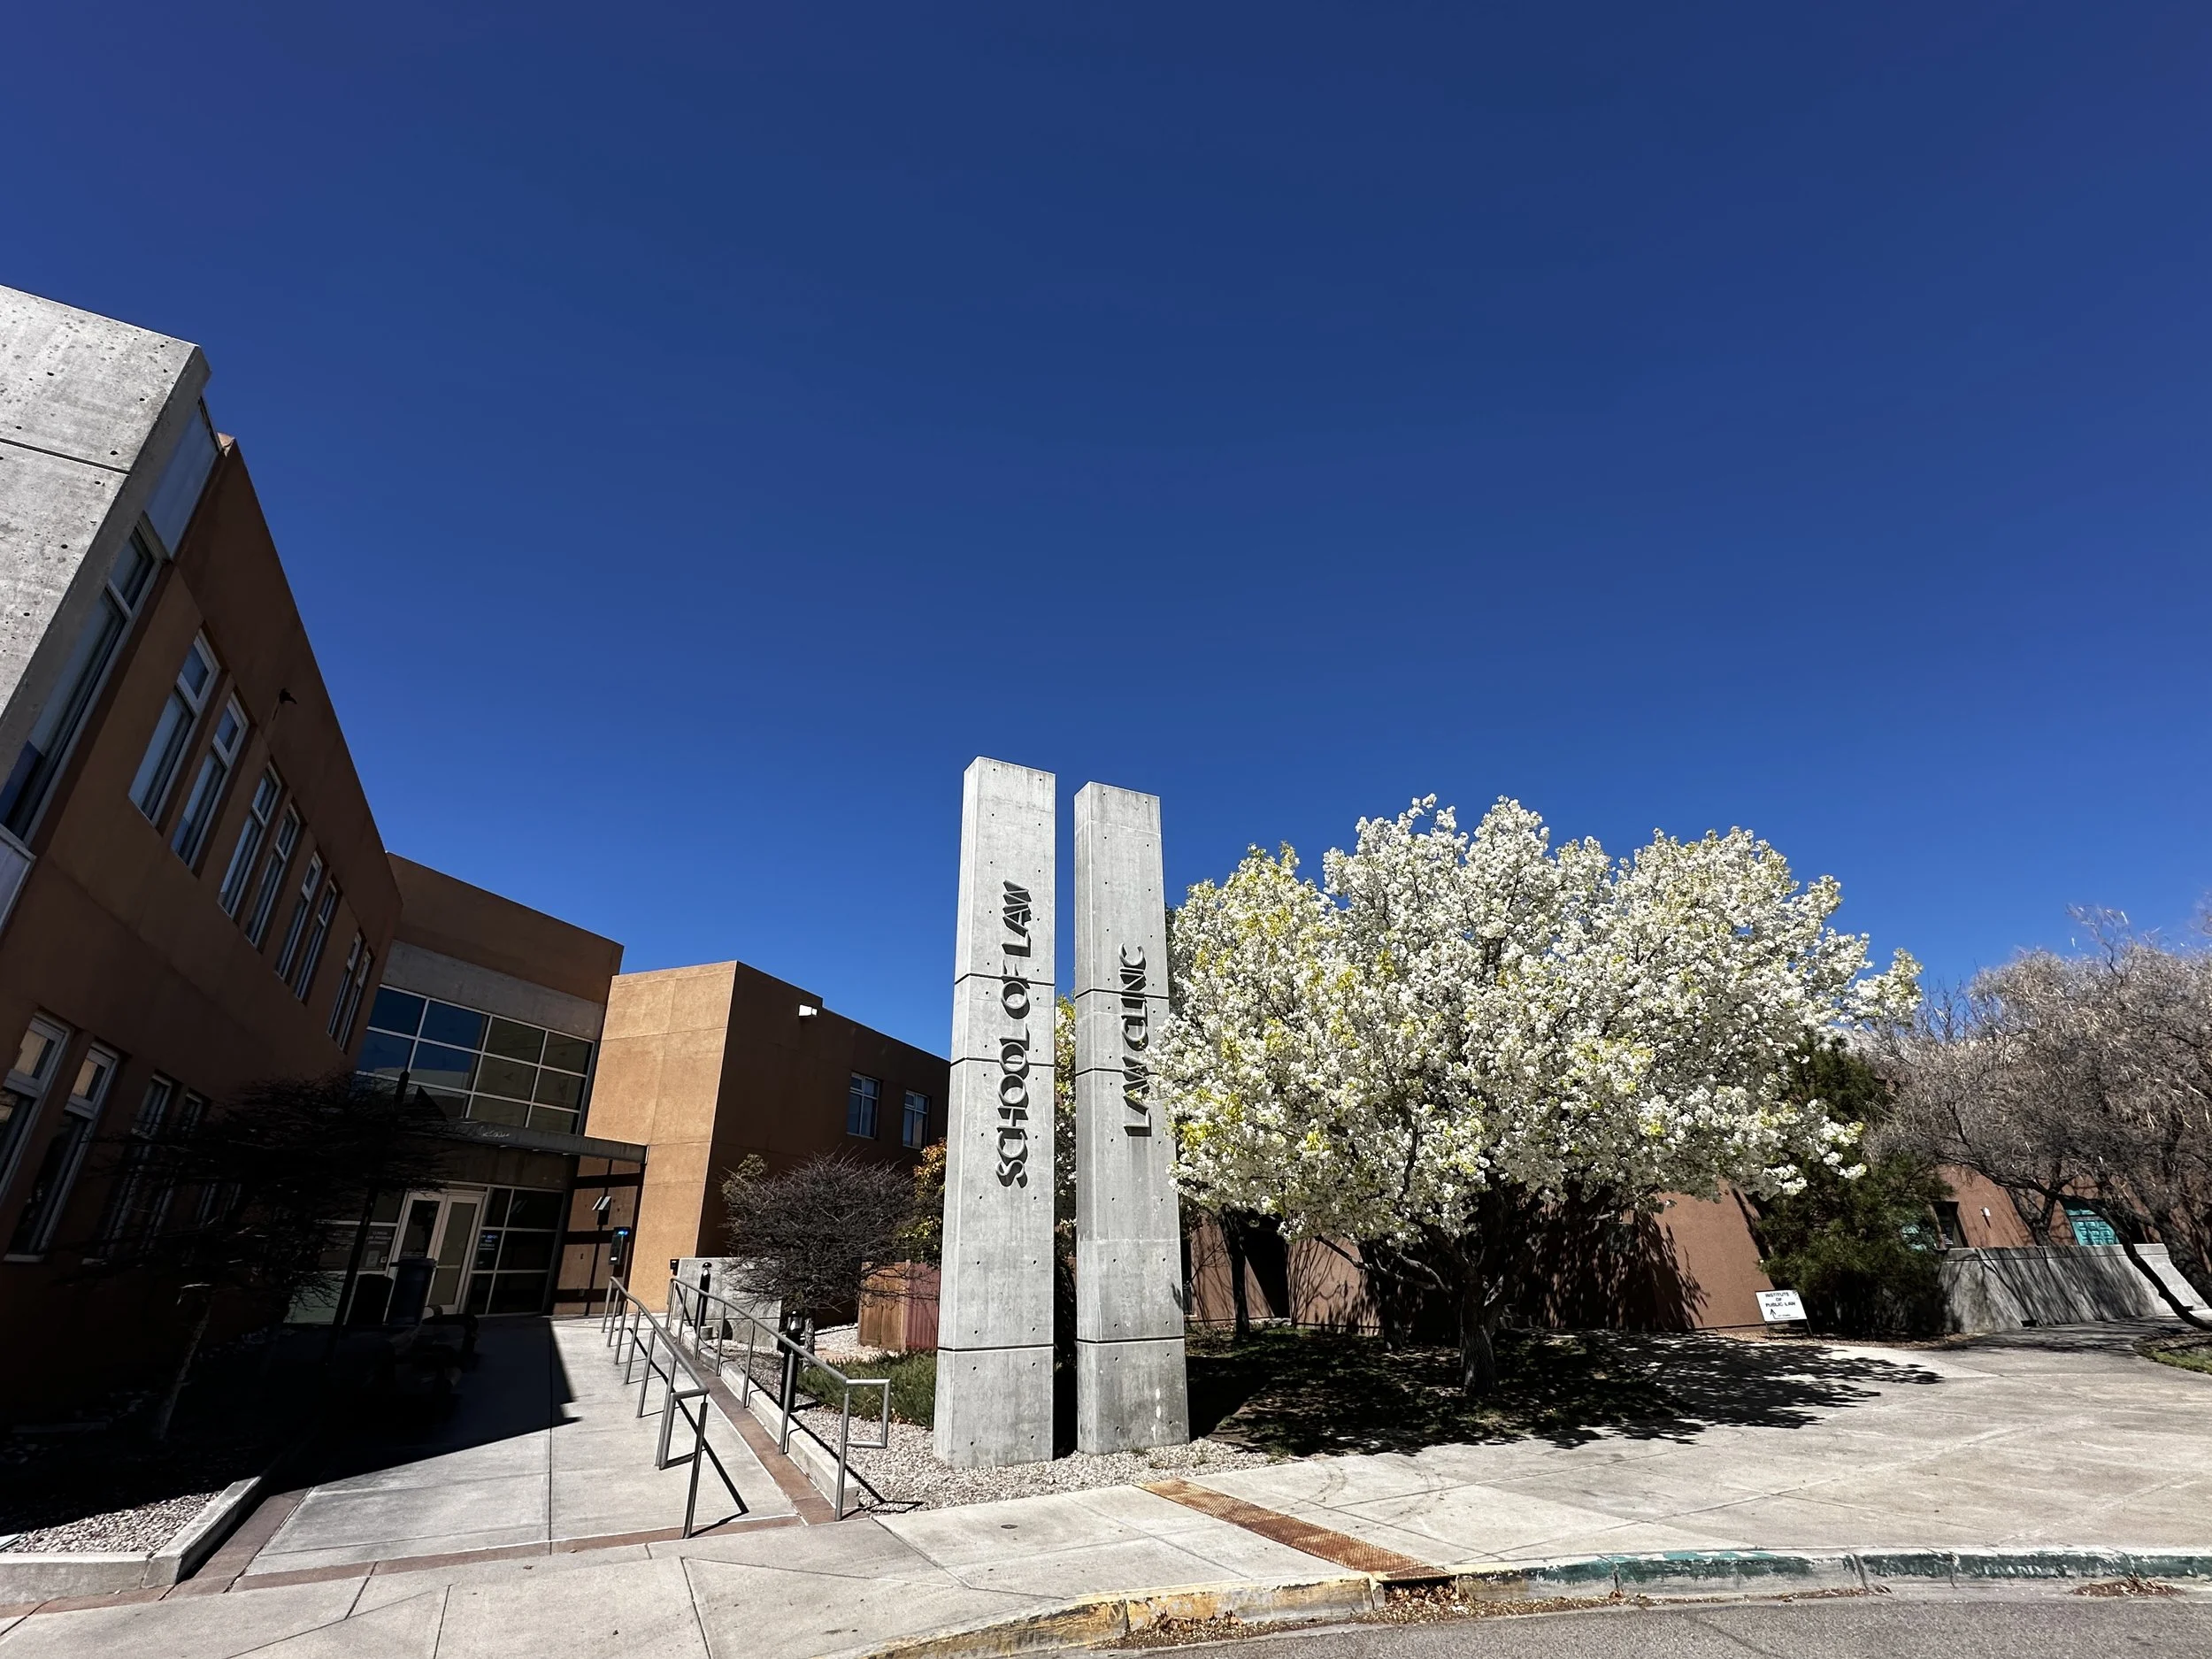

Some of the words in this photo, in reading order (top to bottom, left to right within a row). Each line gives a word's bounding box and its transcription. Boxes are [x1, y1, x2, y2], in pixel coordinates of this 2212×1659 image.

[1002, 879, 1032, 956] LAW
[1001, 959, 1030, 1018] OF
[1118, 942, 1148, 1051] CLINIC
[995, 1023, 1030, 1188] SCHOOL
[1122, 1055, 1152, 1136] LAW
